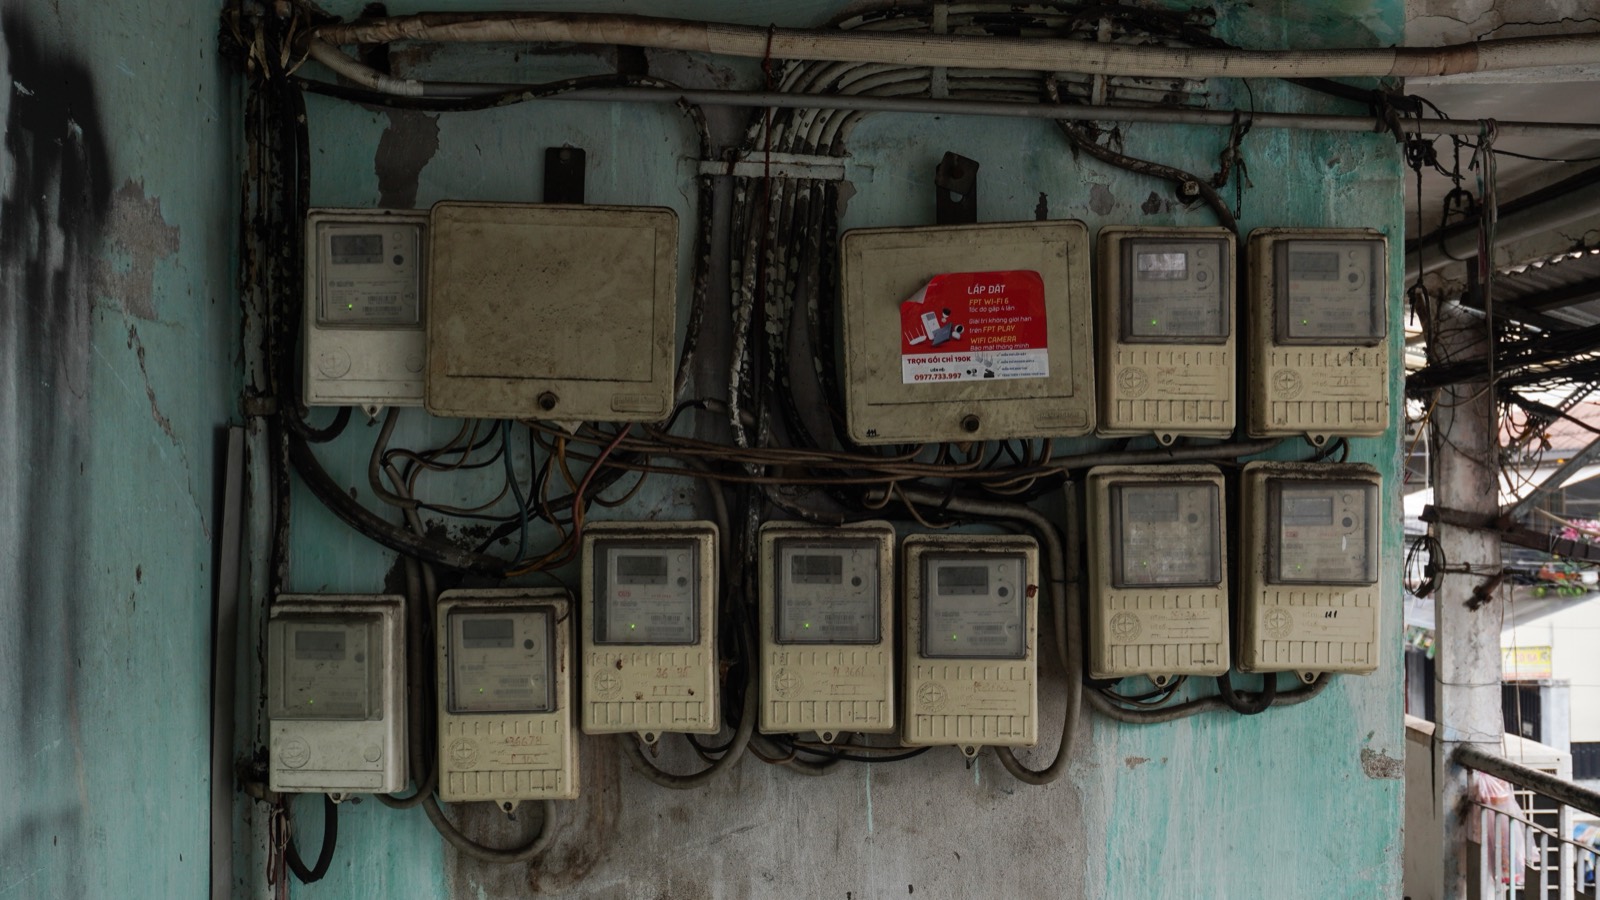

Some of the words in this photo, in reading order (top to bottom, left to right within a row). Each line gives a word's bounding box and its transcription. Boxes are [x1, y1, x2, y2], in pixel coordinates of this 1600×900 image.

[969, 298, 982, 306] FPT
[984, 297, 1004, 305] WI-FI
[1004, 297, 1009, 305] 6
[997, 324, 1016, 332] PLAY
[988, 335, 1017, 344] CAMERA
[914, 373, 962, 381] 0977.733.997
